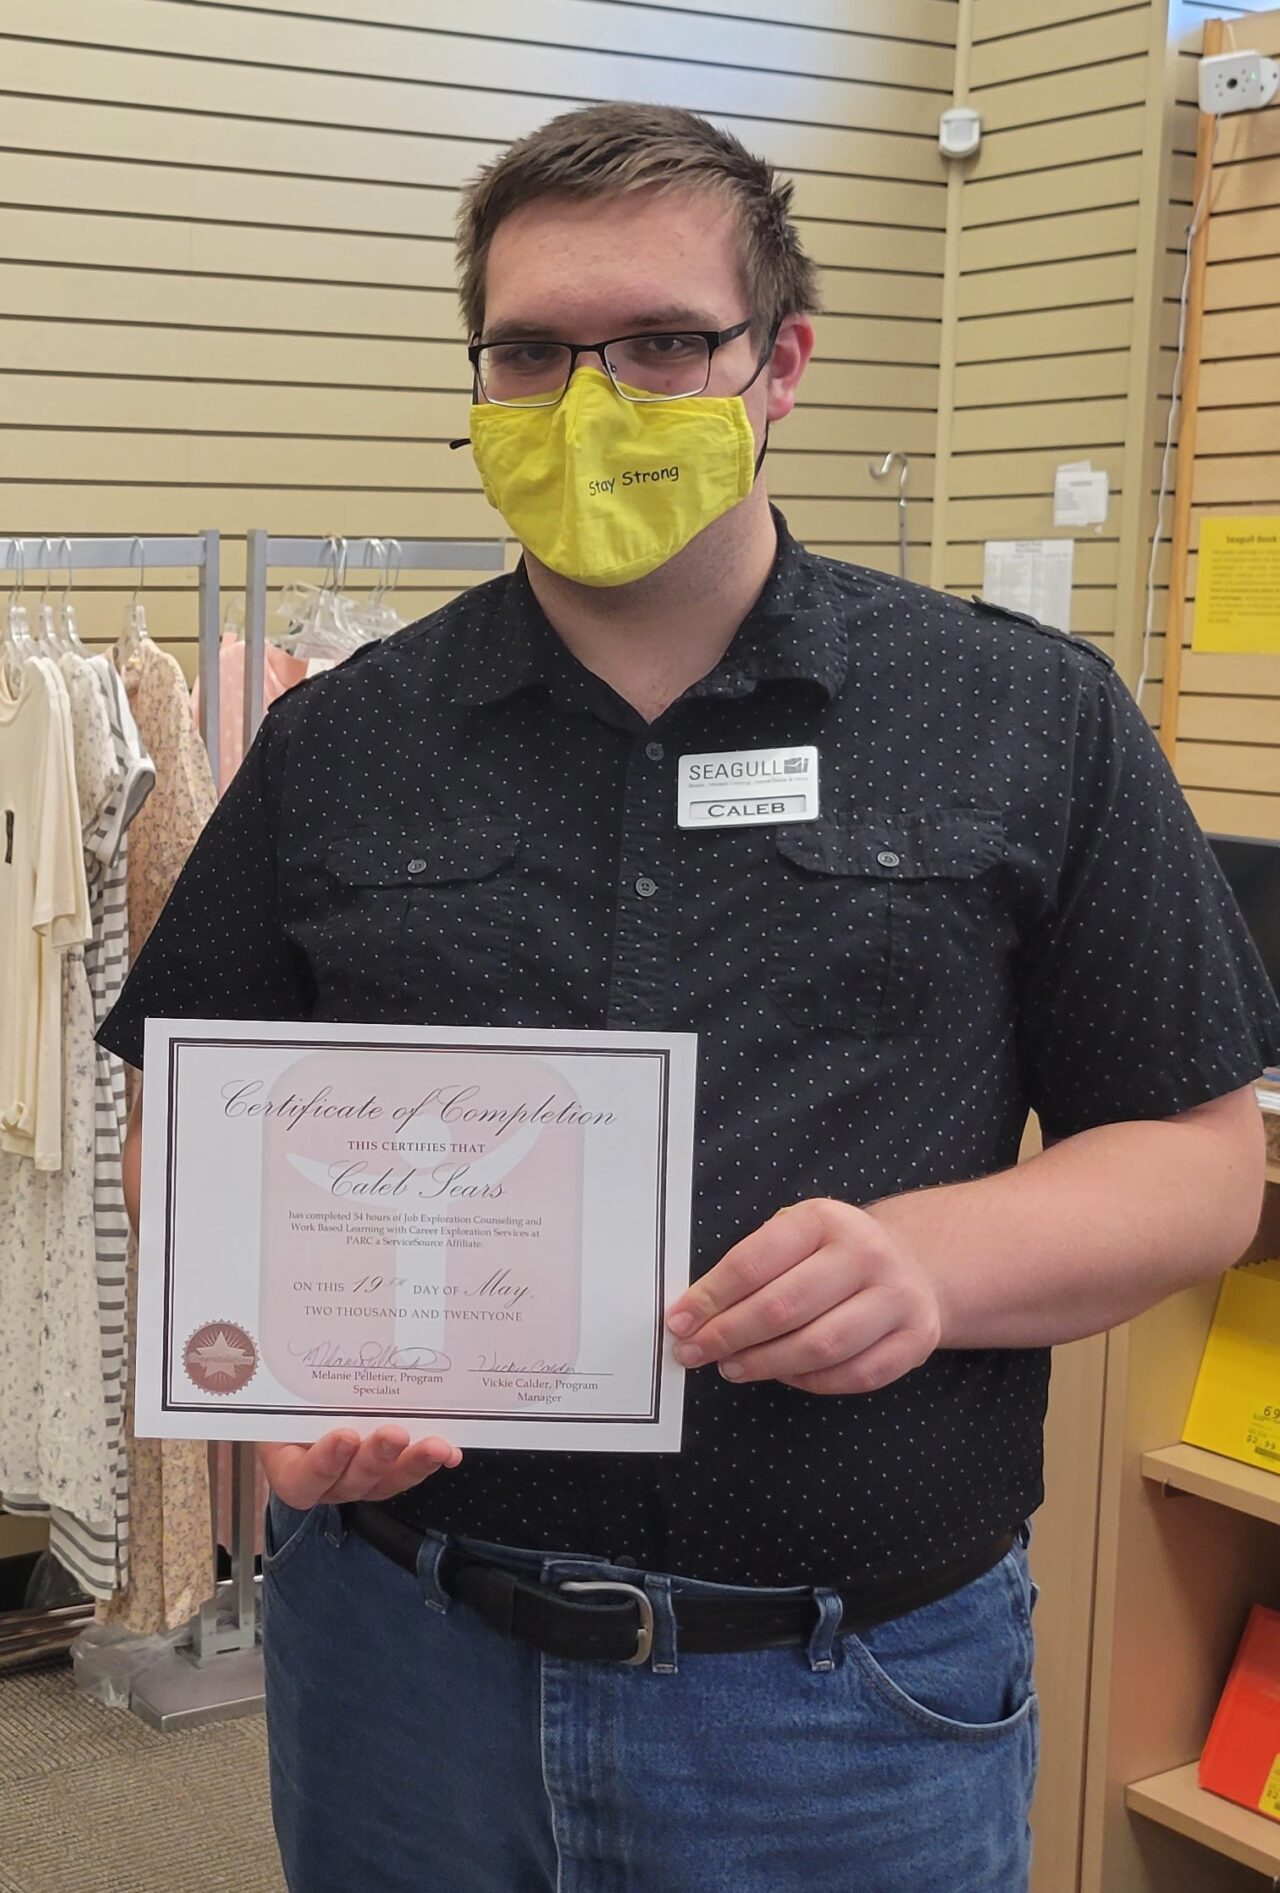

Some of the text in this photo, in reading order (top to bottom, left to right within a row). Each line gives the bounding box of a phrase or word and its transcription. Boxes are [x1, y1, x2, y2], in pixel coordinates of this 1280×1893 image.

[588, 466, 679, 496] Stay Strong
[688, 759, 783, 781] SEAGULL
[707, 802, 786, 818] CALEB
[221, 1080, 618, 1137] Certificate of Completion
[347, 1140, 486, 1154] THIS CERTIFIES THAT
[328, 1159, 506, 1200] Caleb Sears
[288, 1210, 304, 1220] has
[305, 1211, 351, 1223] completed
[366, 1213, 391, 1222] hours
[392, 1213, 402, 1222] of
[403, 1213, 419, 1224] Job
[420, 1214, 471, 1227] Exploration
[473, 1216, 523, 1227] Counseling
[525, 1216, 542, 1226] and
[291, 1222, 540, 1238] Work Based Learning with Career Exploration Services at
[375, 1238, 381, 1246] a
[382, 1236, 444, 1247] ServiceSource
[293, 1281, 312, 1292] ON
[315, 1281, 345, 1292] THIS
[413, 1284, 439, 1296] DAY
[443, 1285, 460, 1296] OF
[304, 1304, 523, 1322] TWO THOUSAND AND TWENTYONE
[312, 1370, 352, 1381] Melanie
[400, 1373, 443, 1385] Program
[482, 1377, 513, 1388] Vickie
[555, 1379, 598, 1392] Program
[353, 1385, 401, 1397] Specialist
[517, 1392, 562, 1405] Manager
